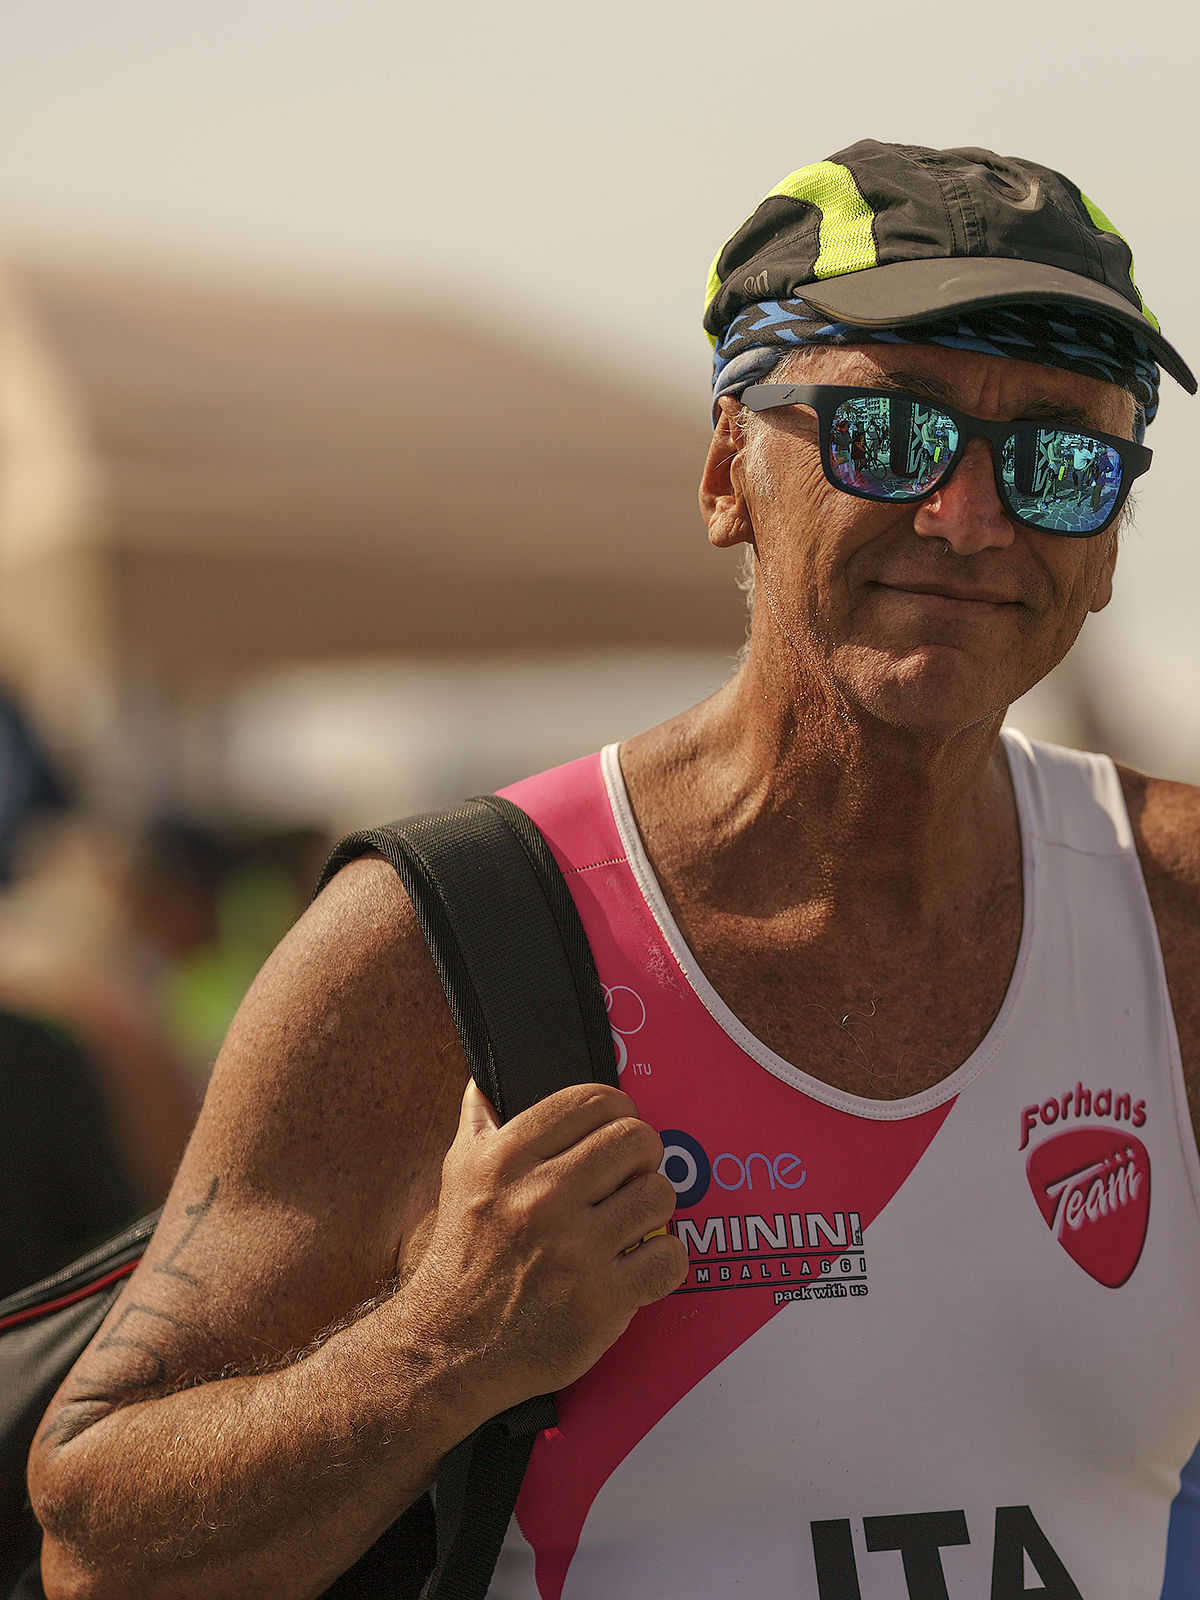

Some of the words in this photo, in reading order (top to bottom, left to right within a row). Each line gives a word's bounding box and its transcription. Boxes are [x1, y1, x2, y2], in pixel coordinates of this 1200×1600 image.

[633, 1063, 652, 1076] ITU
[1018, 1081, 1147, 1152] Forhans
[712, 1152, 807, 1192] one
[1046, 1160, 1143, 1241] Team
[669, 1211, 864, 1256] MININI
[682, 1257, 867, 1286] MBALLAGGI
[774, 1285, 812, 1305] pack
[813, 1283, 847, 1299] with
[849, 1284, 869, 1297] us
[810, 1504, 1084, 1600] ITA
